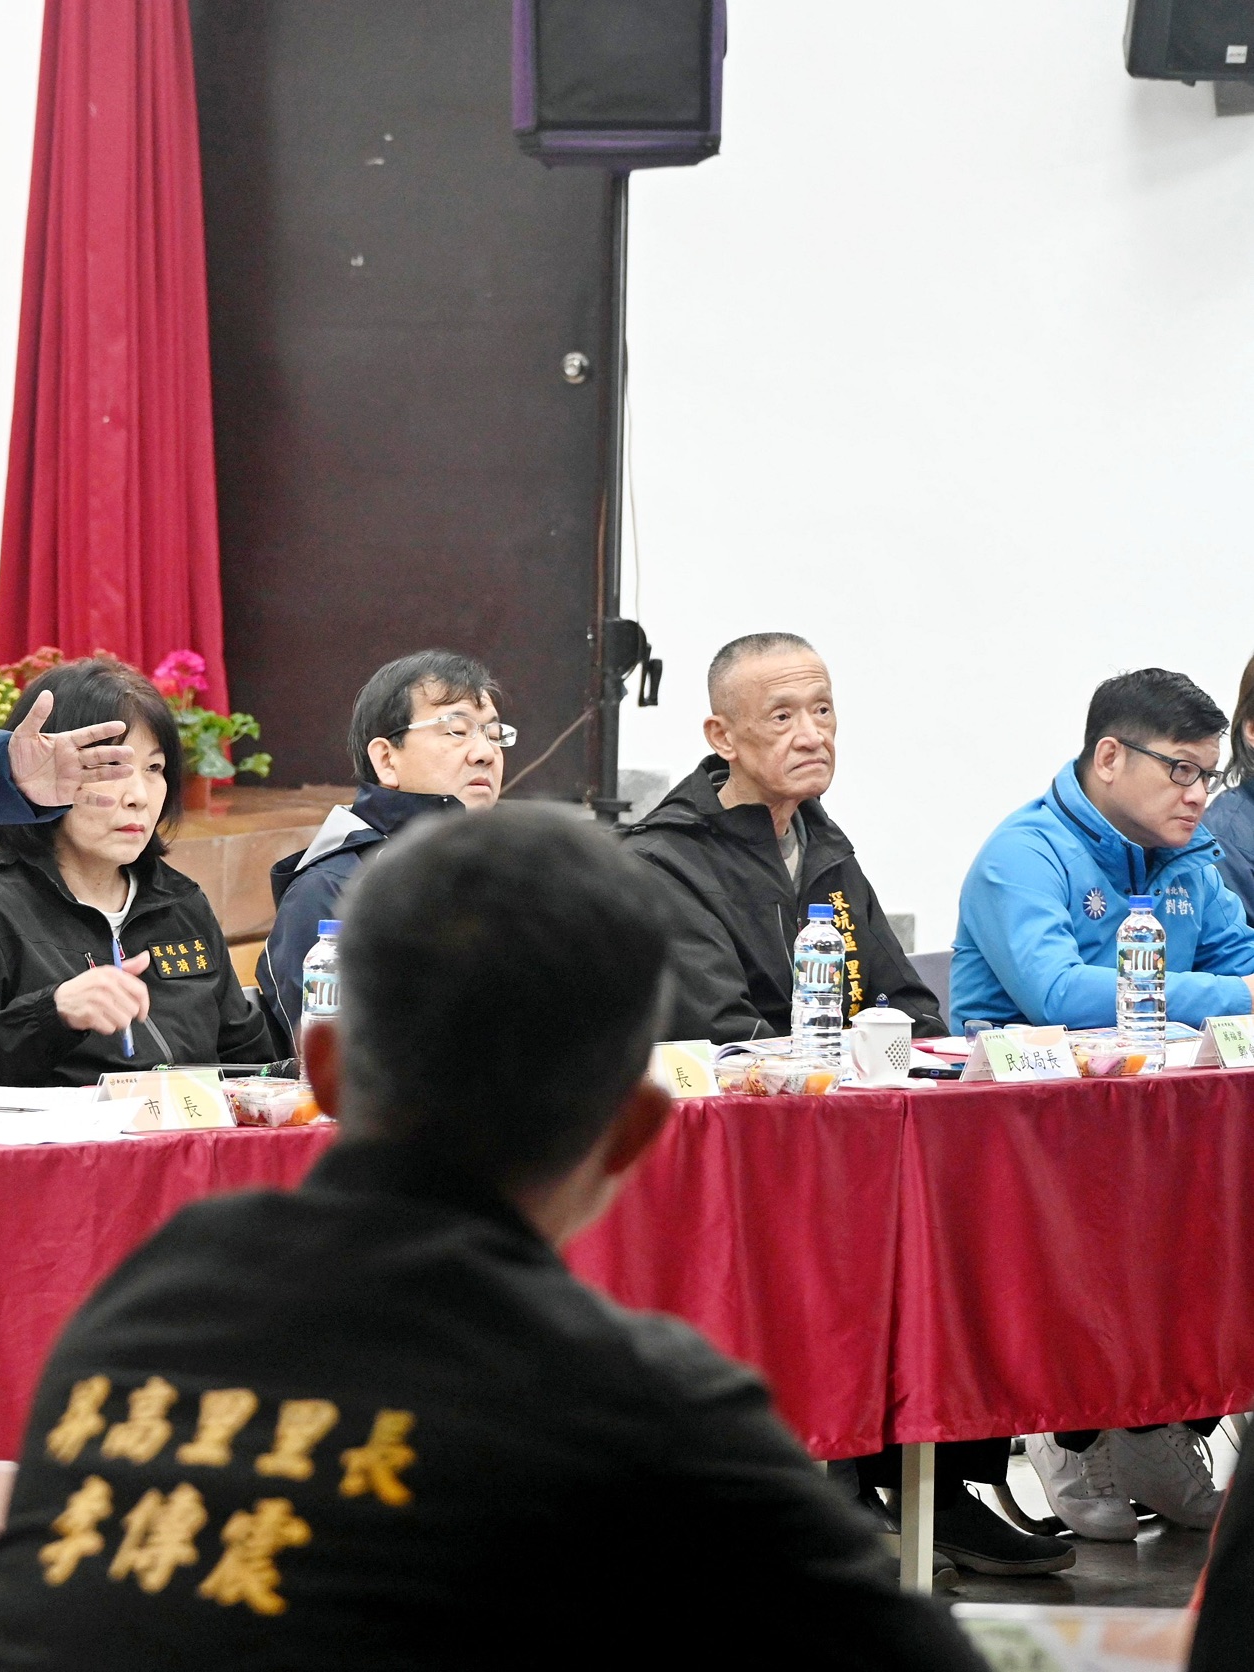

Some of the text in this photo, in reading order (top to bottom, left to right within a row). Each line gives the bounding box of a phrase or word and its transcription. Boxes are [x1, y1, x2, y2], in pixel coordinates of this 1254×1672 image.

[152, 939, 205, 957] 深坑區長
[1005, 1049, 1061, 1072] 民政局長
[144, 1096, 202, 1120] 市長
